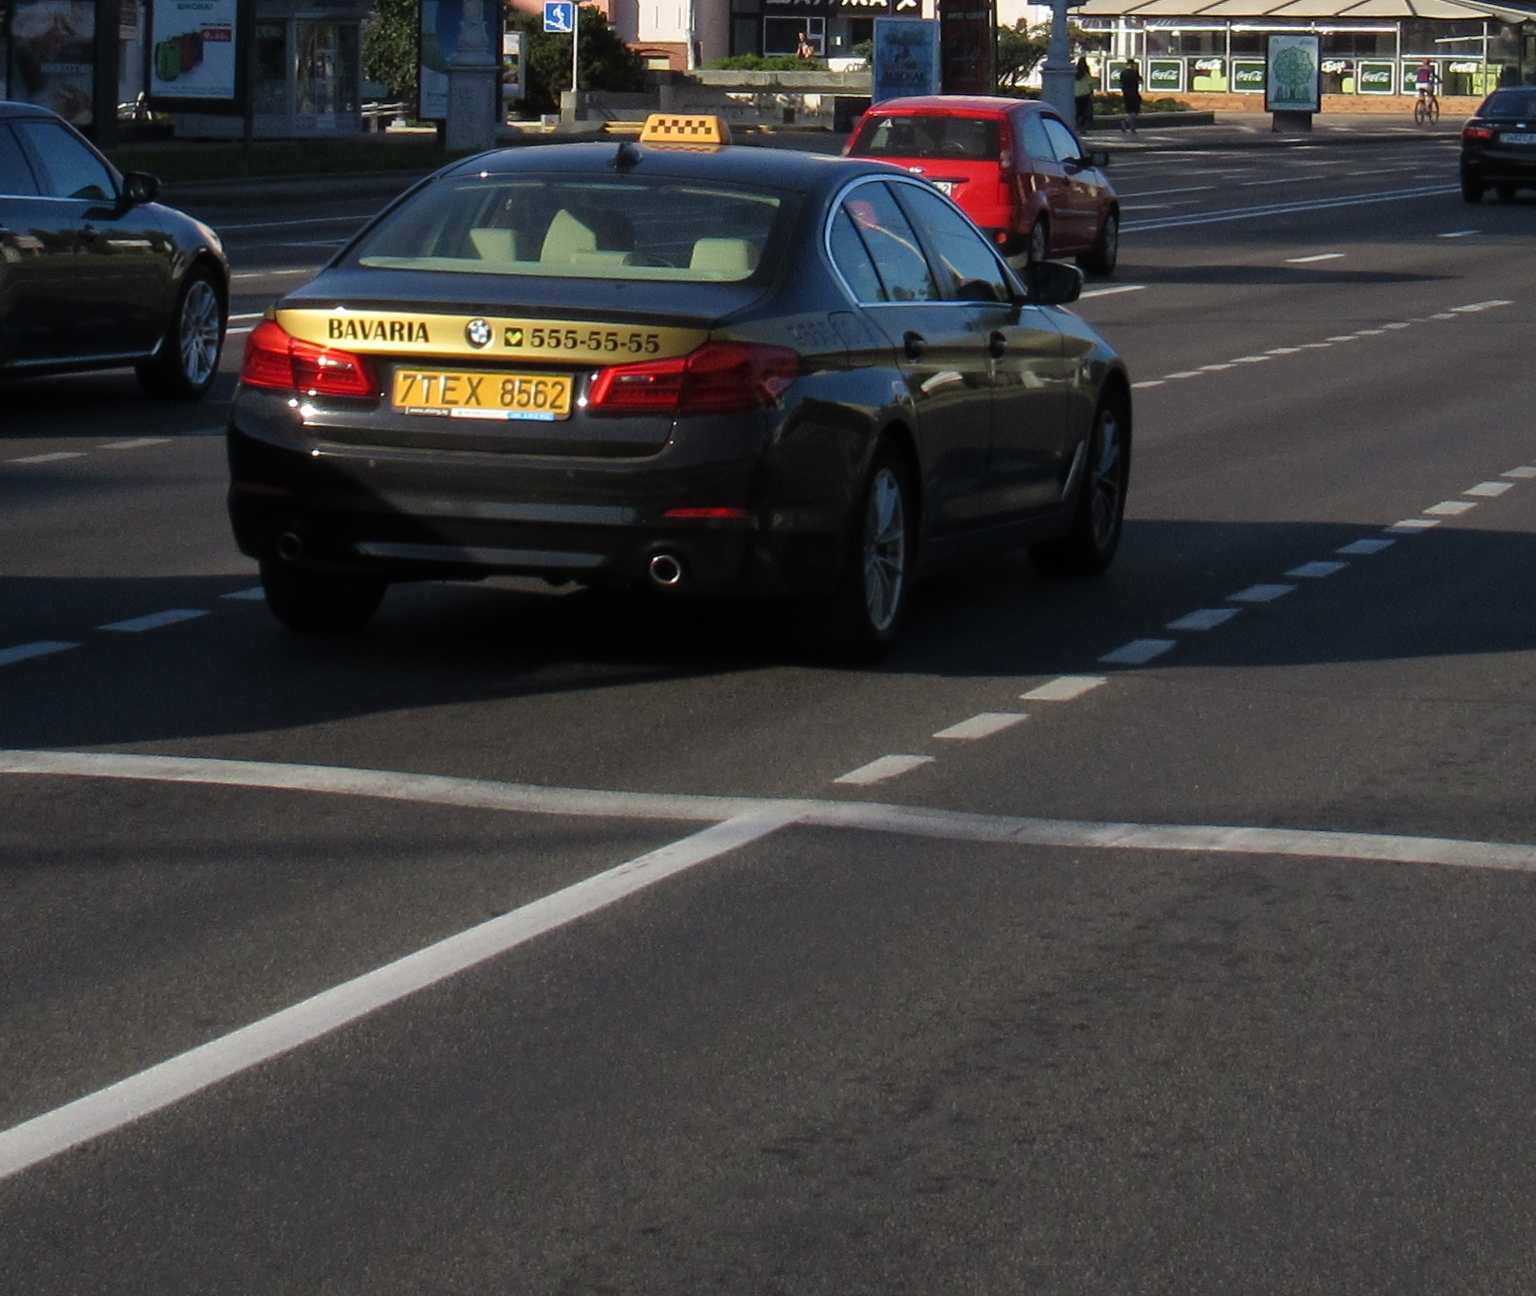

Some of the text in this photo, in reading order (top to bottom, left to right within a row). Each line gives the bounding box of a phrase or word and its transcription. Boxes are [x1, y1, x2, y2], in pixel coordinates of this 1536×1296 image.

[328, 318, 430, 343] BAVARIA
[530, 328, 661, 354] 555-55-55
[500, 377, 565, 410] 8562
